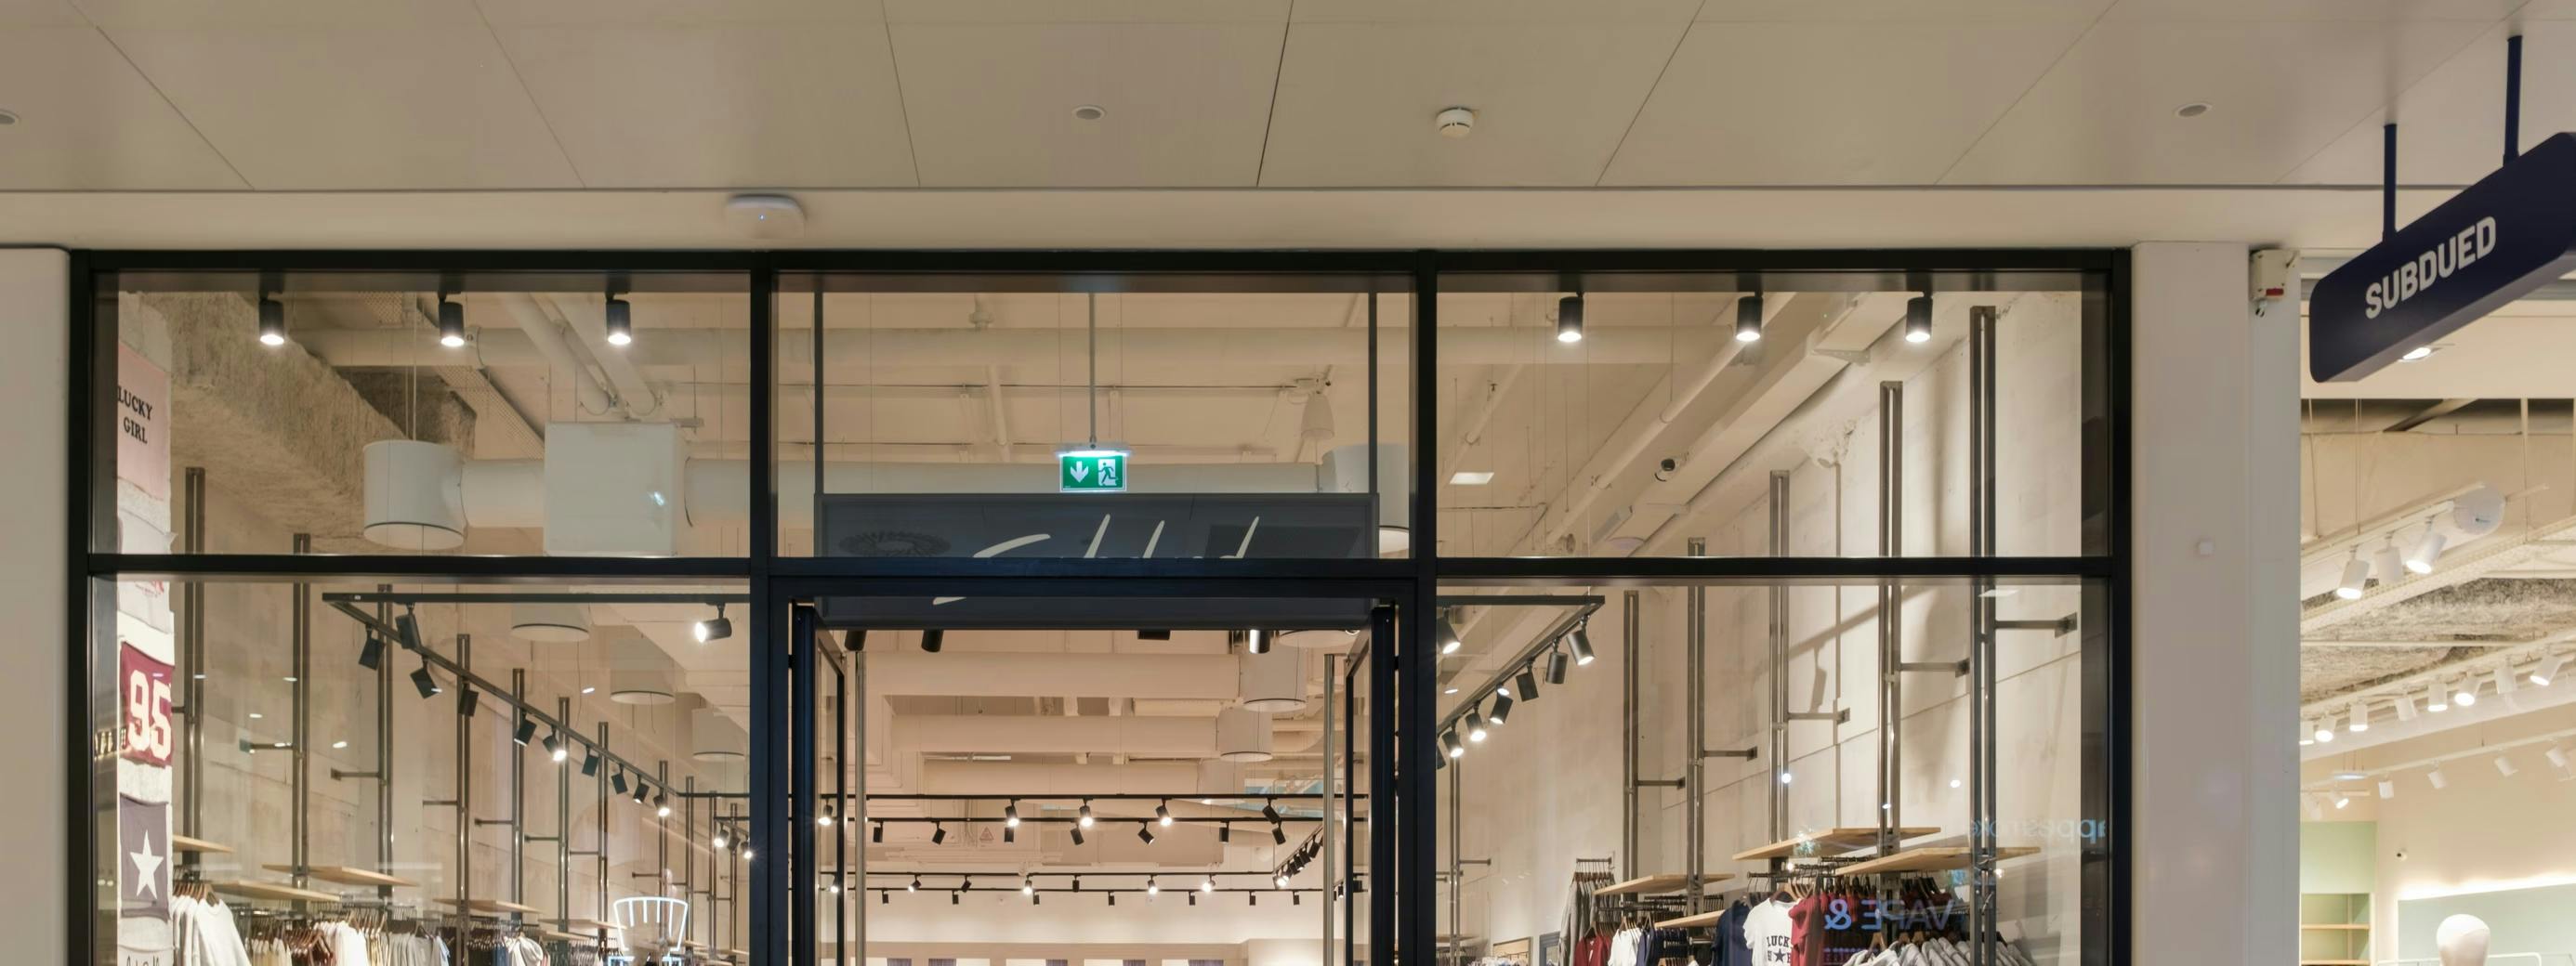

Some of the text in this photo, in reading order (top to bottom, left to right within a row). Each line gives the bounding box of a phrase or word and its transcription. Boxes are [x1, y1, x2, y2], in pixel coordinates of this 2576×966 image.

[2365, 215, 2496, 320] SUBDUED
[117, 385, 152, 421] LUCKY
[123, 416, 148, 444] GIRL
[128, 669, 172, 761] 95
[1767, 934, 1793, 948] LUCK
